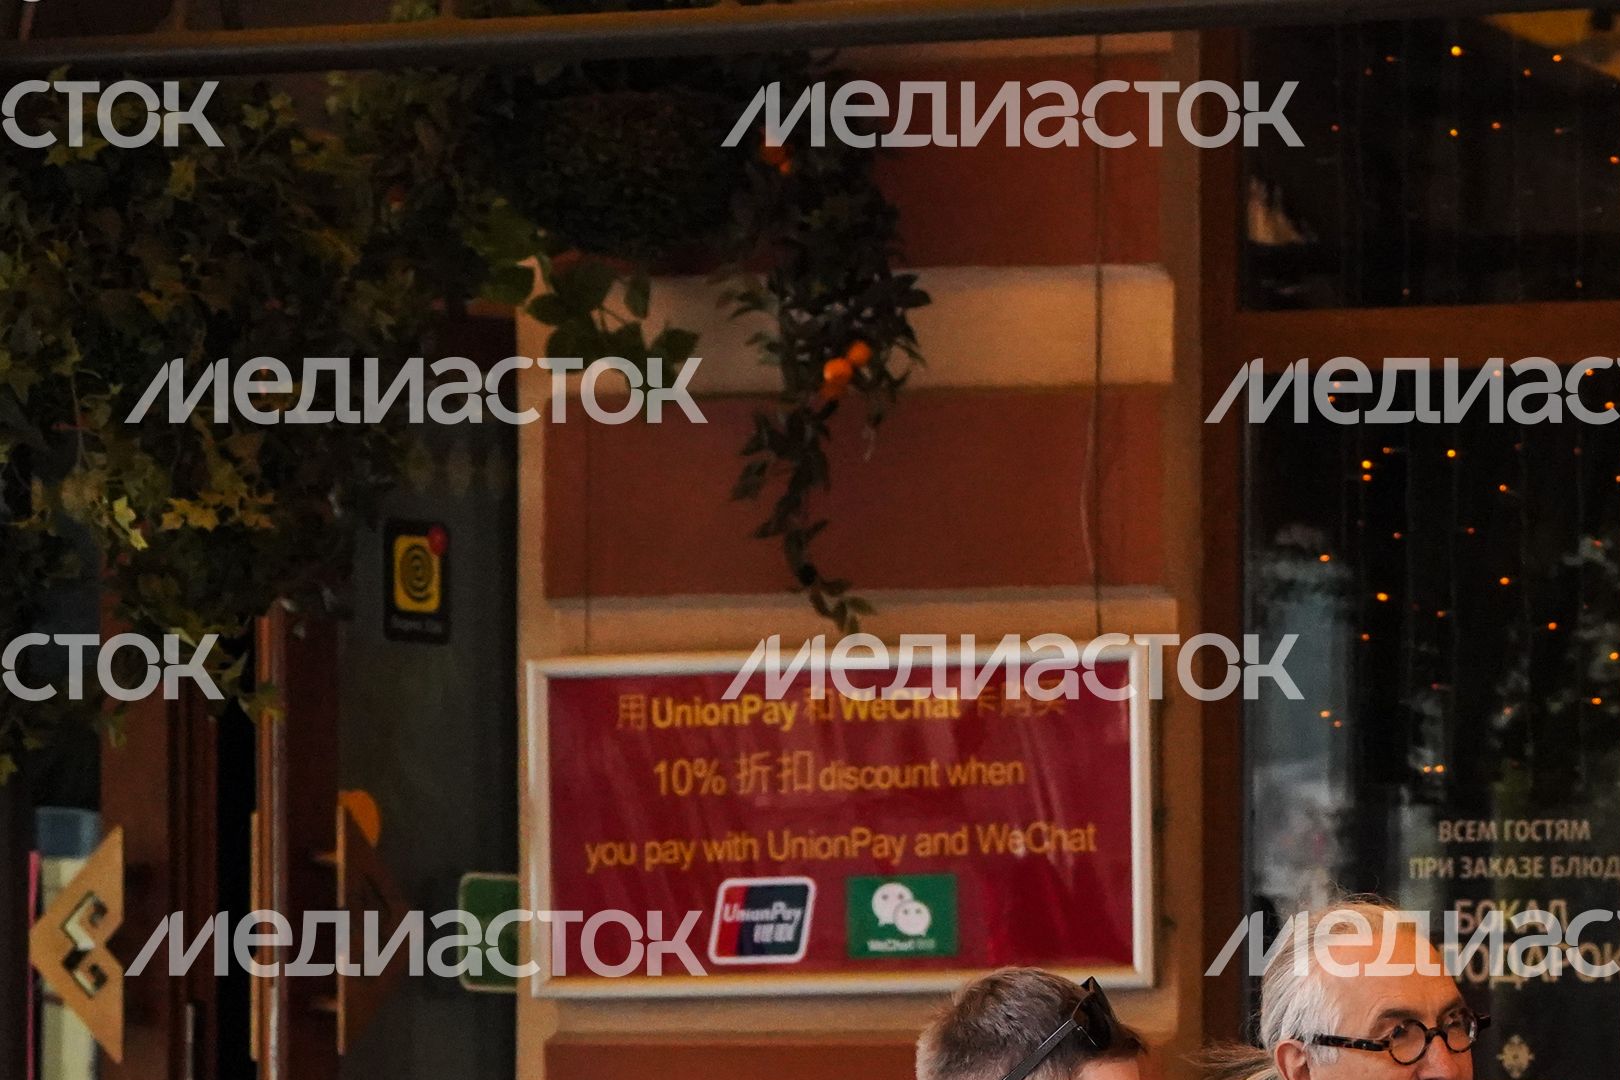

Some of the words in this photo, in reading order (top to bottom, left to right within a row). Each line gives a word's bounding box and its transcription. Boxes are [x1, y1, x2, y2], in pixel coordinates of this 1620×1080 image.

[651, 693, 798, 731] UnionPay
[838, 687, 963, 722] WeChat
[653, 756, 728, 796] 10%
[818, 758, 941, 791] discount
[949, 755, 1026, 786] when
[585, 841, 636, 874] you
[644, 839, 697, 872] pay
[703, 829, 759, 863] with
[767, 828, 907, 866] UnionPay
[914, 823, 970, 857] and
[975, 821, 1097, 855] WeChat
[1438, 820, 1498, 842] ВСЕМ
[1503, 819, 1592, 841] ГОСТЯМ
[1408, 857, 1455, 879] ПРИ
[1460, 856, 1544, 878] ЗАКАЗЕ
[1454, 899, 1569, 936] БОКАЛ
